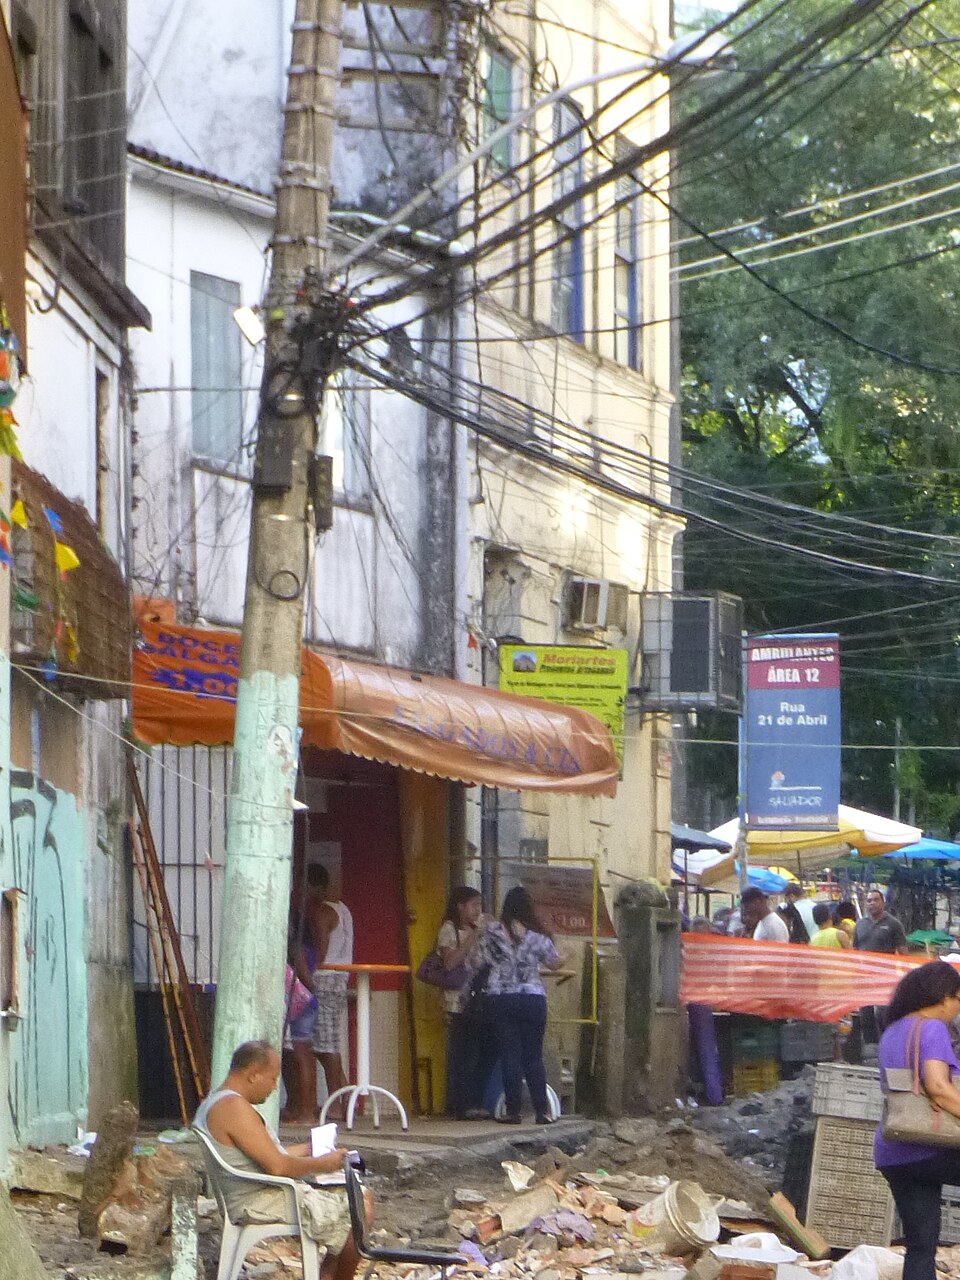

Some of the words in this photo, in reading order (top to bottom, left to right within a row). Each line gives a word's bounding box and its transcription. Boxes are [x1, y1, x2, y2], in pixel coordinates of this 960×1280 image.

[767, 666, 801, 683] ÁREA
[805, 668, 820, 683] 12
[780, 702, 805, 713] Rua
[757, 715, 773, 726] 21
[776, 714, 793, 726] de
[796, 714, 828, 726] Abril
